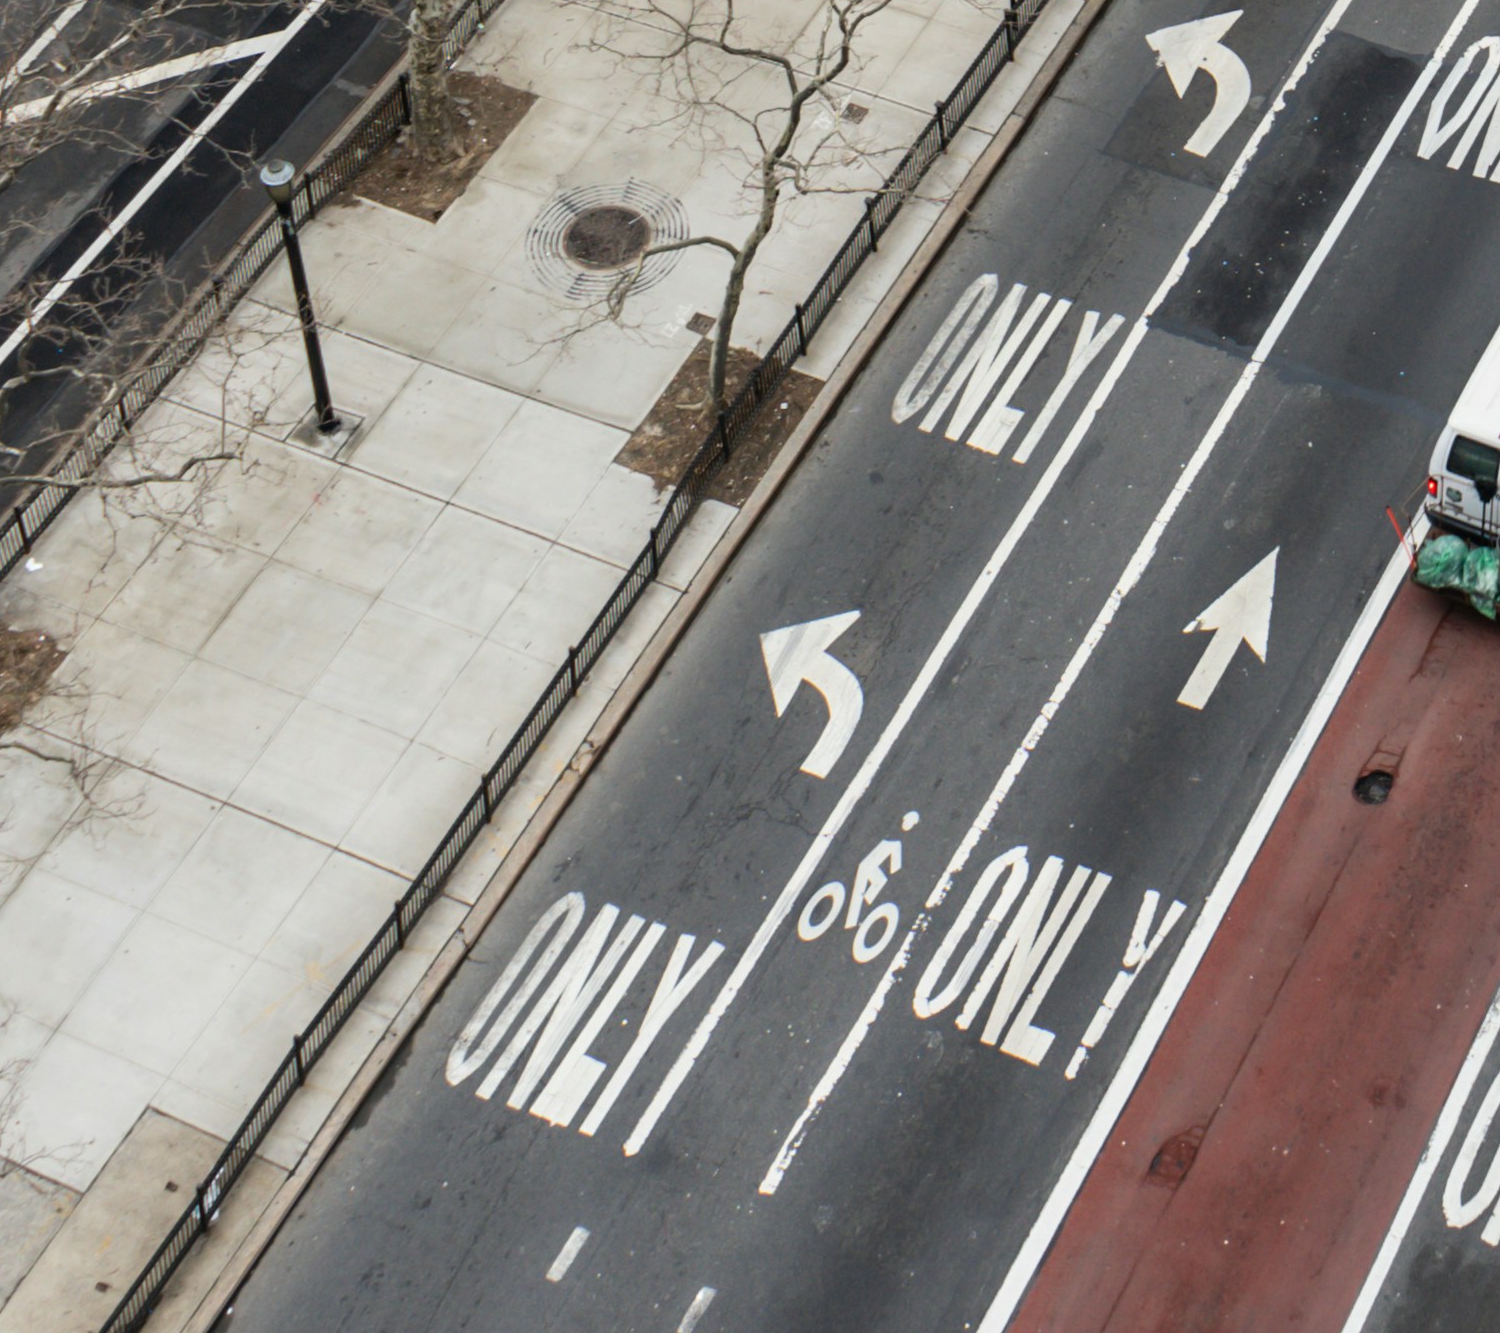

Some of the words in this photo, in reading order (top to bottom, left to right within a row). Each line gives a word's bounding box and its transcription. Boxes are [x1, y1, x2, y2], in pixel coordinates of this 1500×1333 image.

[890, 272, 1126, 464] ONLY
[444, 890, 727, 1136] ONLY
[912, 844, 1188, 1079] ONLY
